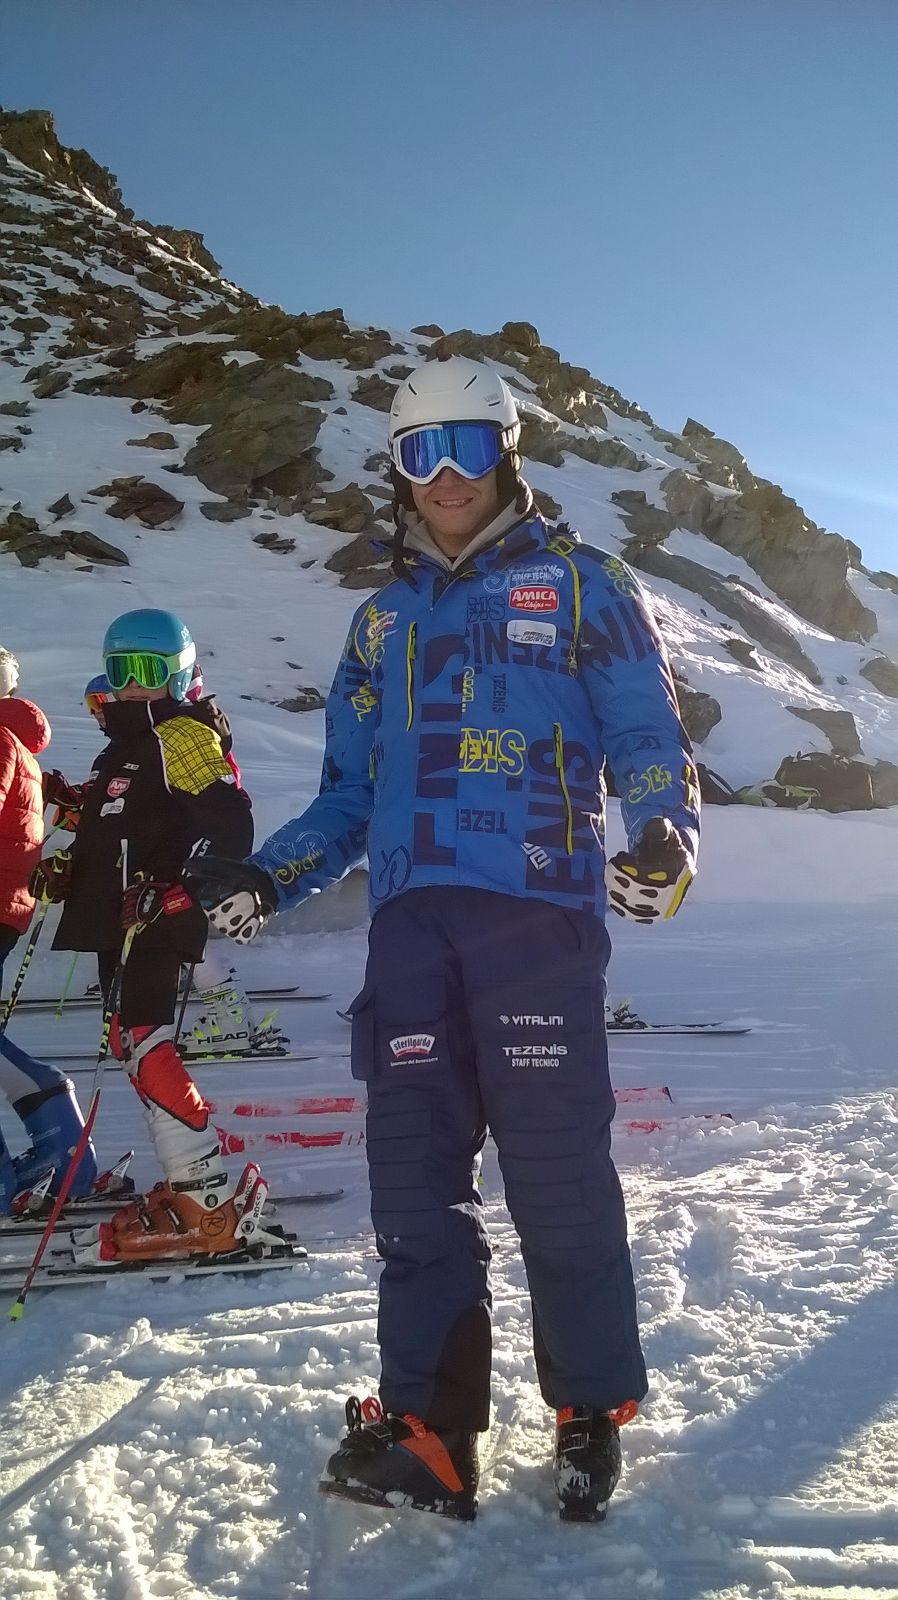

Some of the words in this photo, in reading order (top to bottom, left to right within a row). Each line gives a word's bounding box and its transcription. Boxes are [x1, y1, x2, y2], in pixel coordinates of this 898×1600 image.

[511, 590, 557, 602] AMICA
[523, 600, 545, 610] Chips
[492, 672, 509, 714] TEZENIS
[456, 808, 507, 835] TEZE
[511, 1015, 564, 1026] VITALINI
[99, 1011, 113, 1054] LEKI
[197, 1031, 249, 1045] HEAD
[502, 1043, 568, 1057] TEZENIS
[511, 1058, 530, 1068] STAFF
[531, 1058, 560, 1068] TECNICO
[252, 1192, 262, 1218] ROSSI
